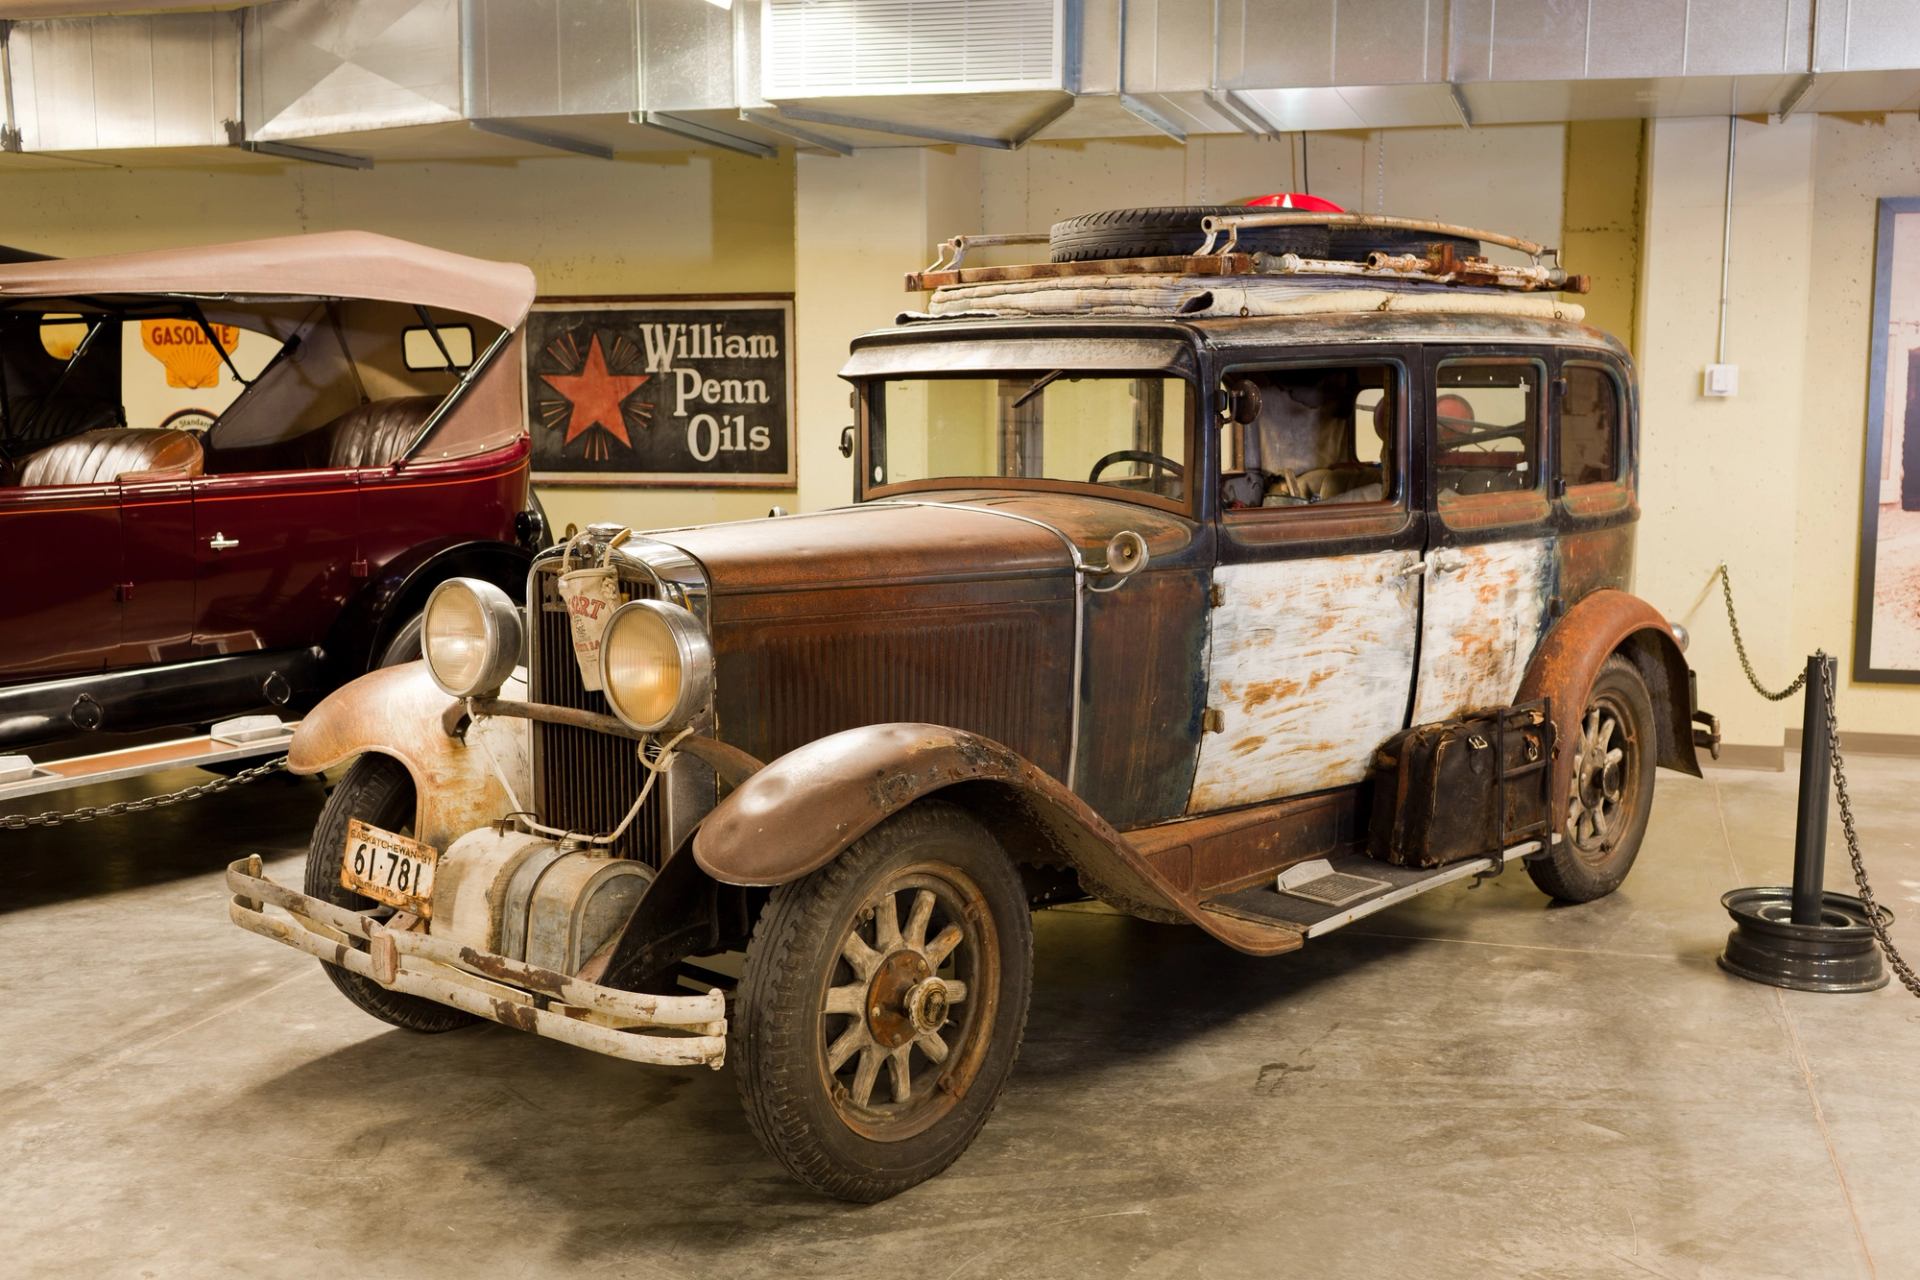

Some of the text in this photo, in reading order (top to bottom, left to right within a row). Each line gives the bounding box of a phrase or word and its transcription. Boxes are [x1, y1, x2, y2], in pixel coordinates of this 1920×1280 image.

[639, 323, 778, 373] William
[672, 367, 770, 417] Penn
[178, 418, 210, 428] Standar
[687, 413, 771, 463] Oils
